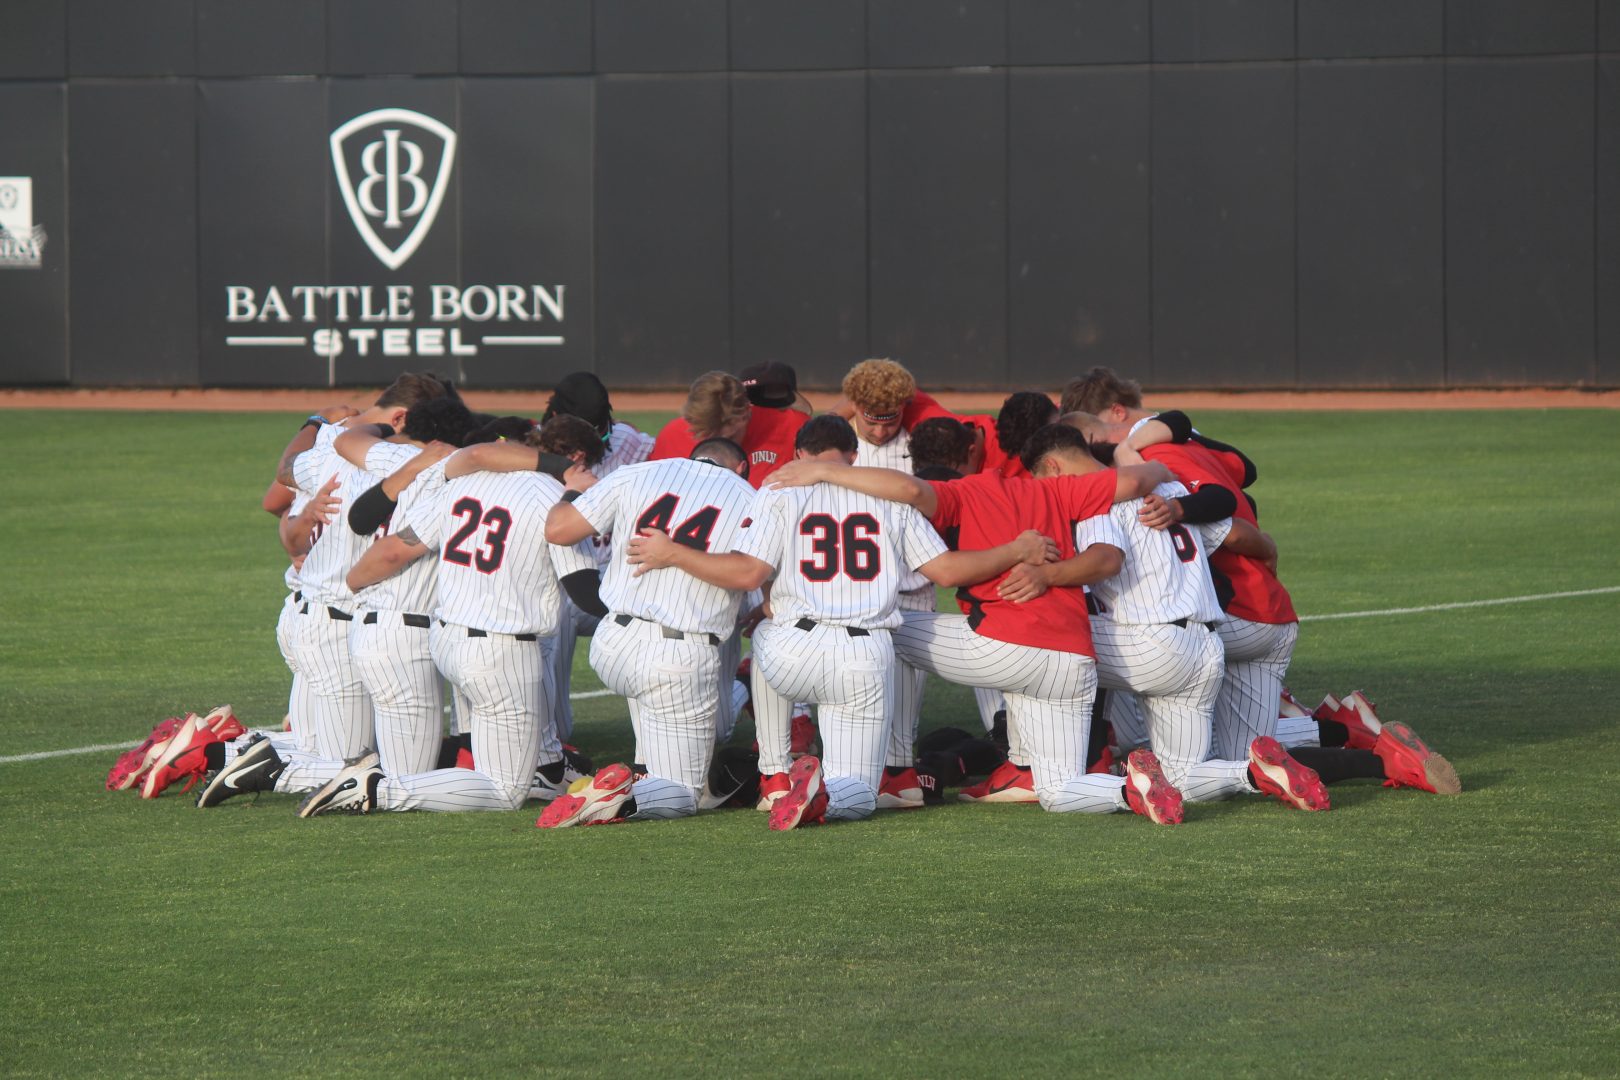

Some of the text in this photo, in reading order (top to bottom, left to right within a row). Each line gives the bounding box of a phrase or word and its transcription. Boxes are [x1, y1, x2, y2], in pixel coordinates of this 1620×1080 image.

[226, 284, 565, 323] BATTLE BORN
[313, 328, 478, 356] STEEL
[751, 450, 777, 465] UNLV
[442, 496, 512, 575] 23
[635, 492, 721, 553] 44
[799, 512, 881, 582] 36
